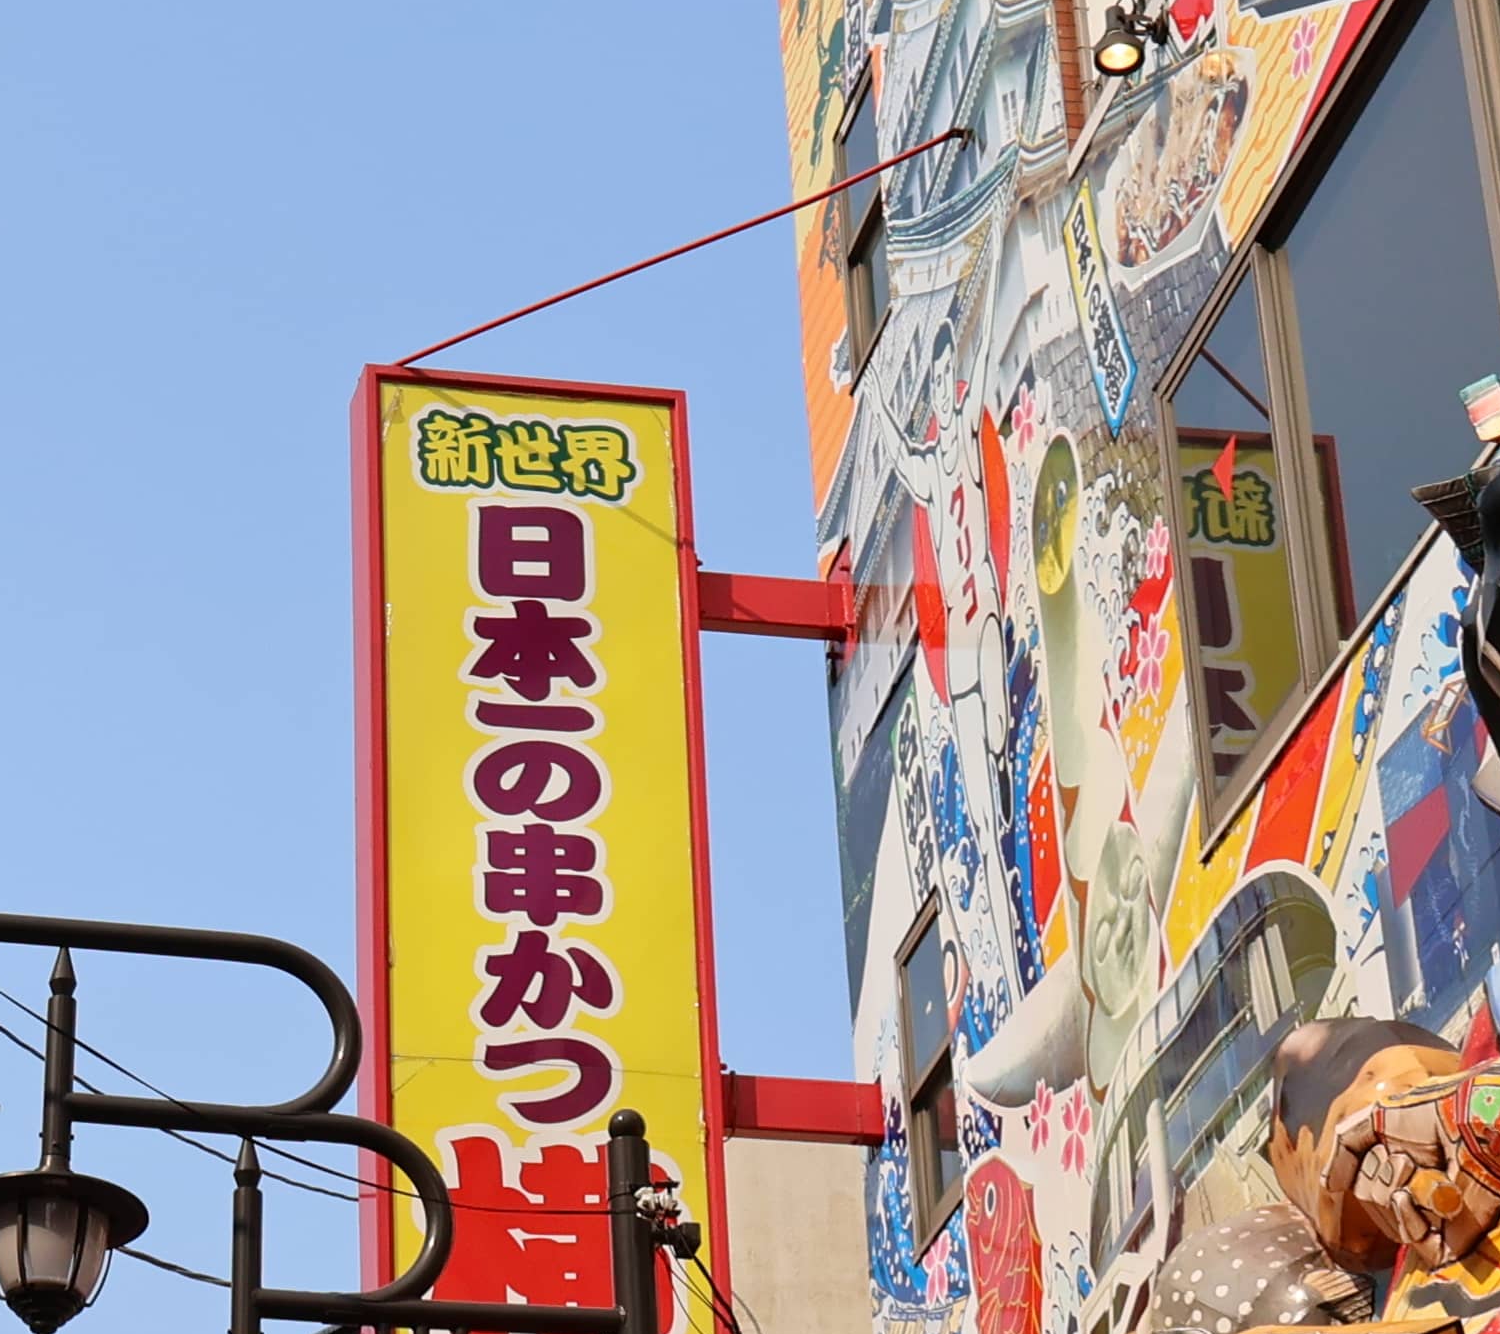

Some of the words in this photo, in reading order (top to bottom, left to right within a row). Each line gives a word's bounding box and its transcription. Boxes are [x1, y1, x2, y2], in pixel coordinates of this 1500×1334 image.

[418, 410, 636, 500] 新世界
[948, 481, 979, 625] グリコ
